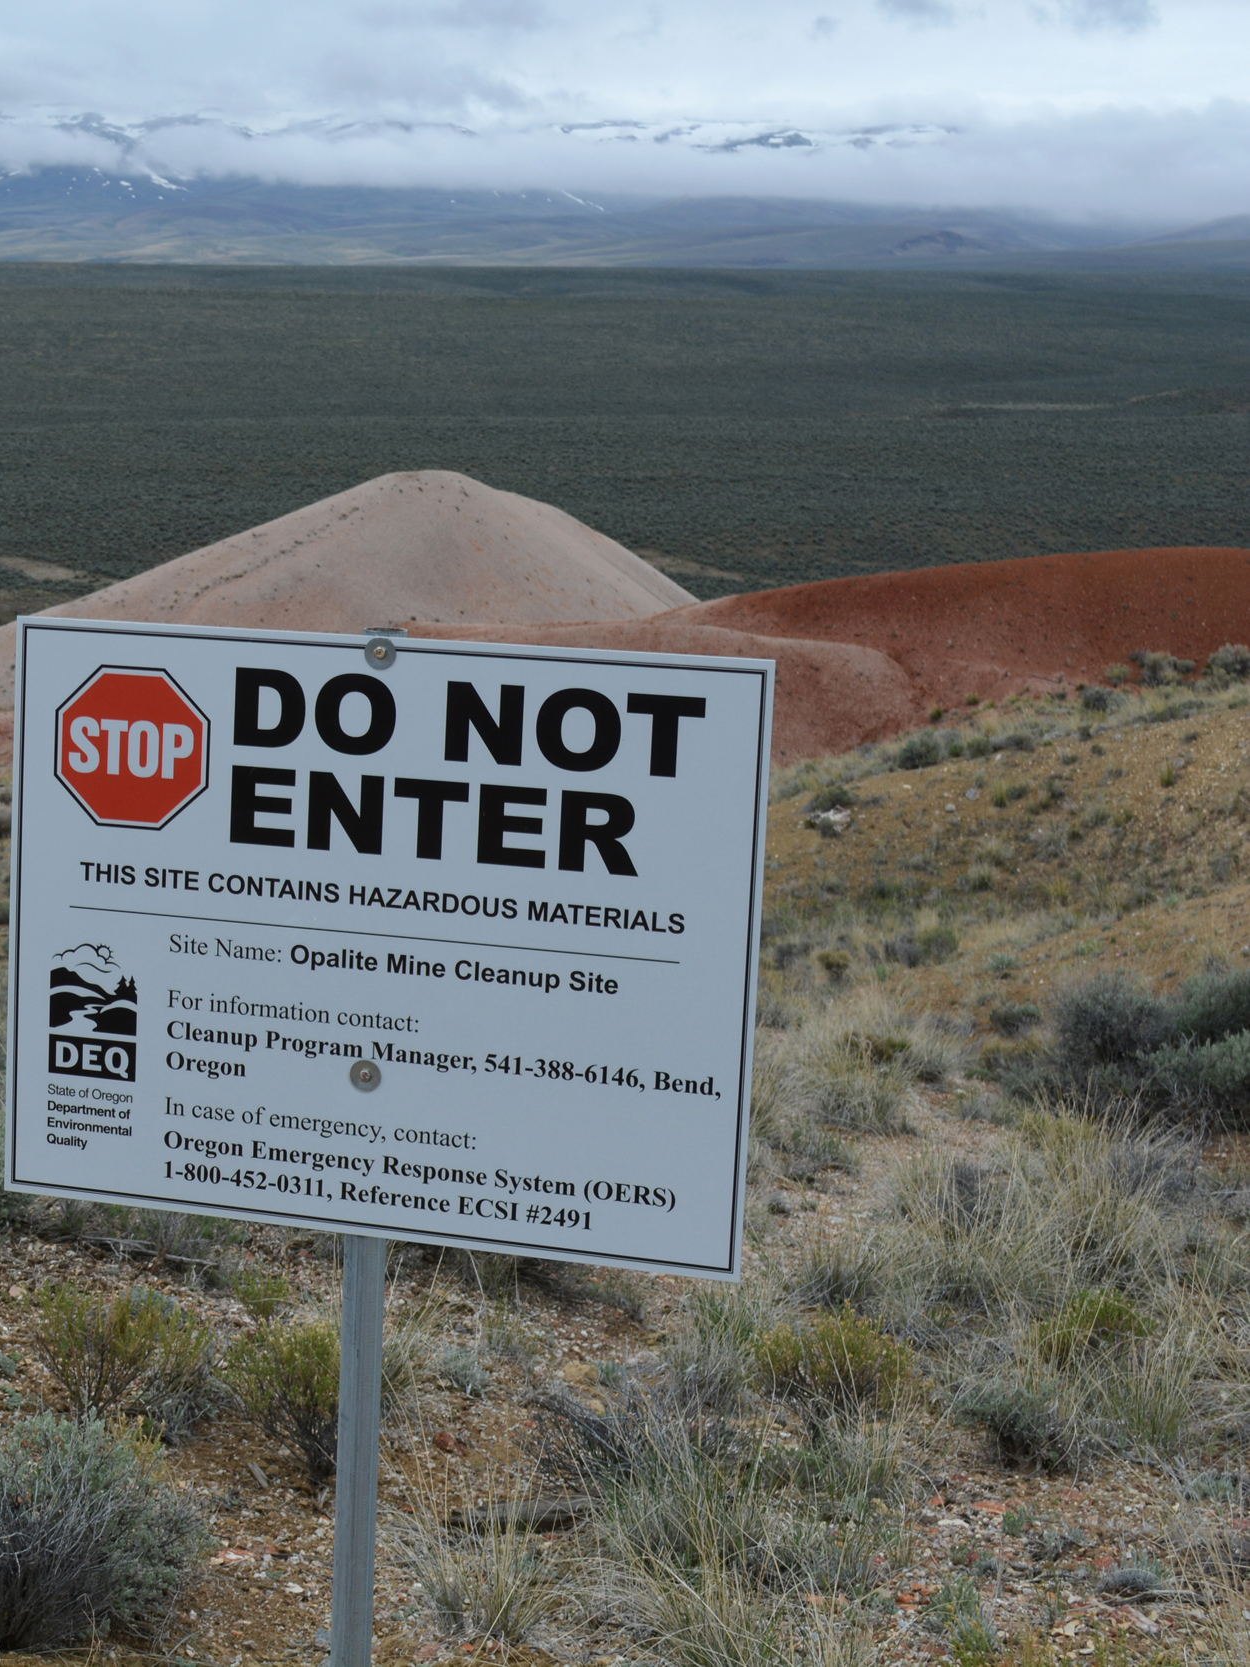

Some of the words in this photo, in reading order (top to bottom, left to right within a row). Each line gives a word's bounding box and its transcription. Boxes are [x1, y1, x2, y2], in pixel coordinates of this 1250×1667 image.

[68, 715, 195, 779] STOP
[233, 667, 396, 756] DO
[444, 680, 706, 778] NOT
[230, 765, 638, 877] ENTER
[80, 861, 136, 885] THIS
[144, 867, 199, 891] SITE
[208, 873, 340, 903] CONTAINS
[349, 885, 518, 919] HAZARDOUS
[528, 900, 685, 934] MATERIALS
[170, 934, 208, 955] Site
[215, 938, 281, 963] Name:
[290, 944, 378, 971] Opalite
[387, 953, 446, 978] Mine
[455, 960, 560, 993] Cleanup
[569, 971, 618, 995] Site
[168, 990, 203, 1010] For
[210, 993, 329, 1024] information
[337, 1012, 419, 1033] contact:
[55, 1041, 130, 1079] DEQ
[166, 1051, 245, 1079] Oregon
[167, 1021, 257, 1052] Cleanup
[266, 1031, 362, 1058] Program
[370, 1041, 477, 1074] Manager,
[484, 1054, 645, 1092] 541-388-6146,
[654, 1071, 721, 1100] Bend,
[47, 1083, 76, 1097] State
[78, 1088, 89, 1098] of
[91, 1088, 133, 1105] Oregon
[47, 1100, 116, 1119] Department
[118, 1109, 131, 1120] of
[46, 1133, 88, 1150] Quality
[47, 1117, 132, 1137] Environmental
[165, 1097, 184, 1116] In
[192, 1105, 235, 1122] case
[242, 1107, 266, 1125] of
[269, 1114, 386, 1143] emergency,
[394, 1128, 476, 1150] contact:
[163, 1161, 334, 1203] 1-800-452-0311,
[340, 1182, 450, 1213] Reference
[458, 1196, 518, 1221] ECSI
[526, 1204, 592, 1230] #2491
[164, 1131, 243, 1158] Oregon
[252, 1140, 375, 1177] Emergency
[382, 1156, 487, 1186] Response
[494, 1169, 575, 1196] System
[584, 1180, 676, 1212] (OERS)
